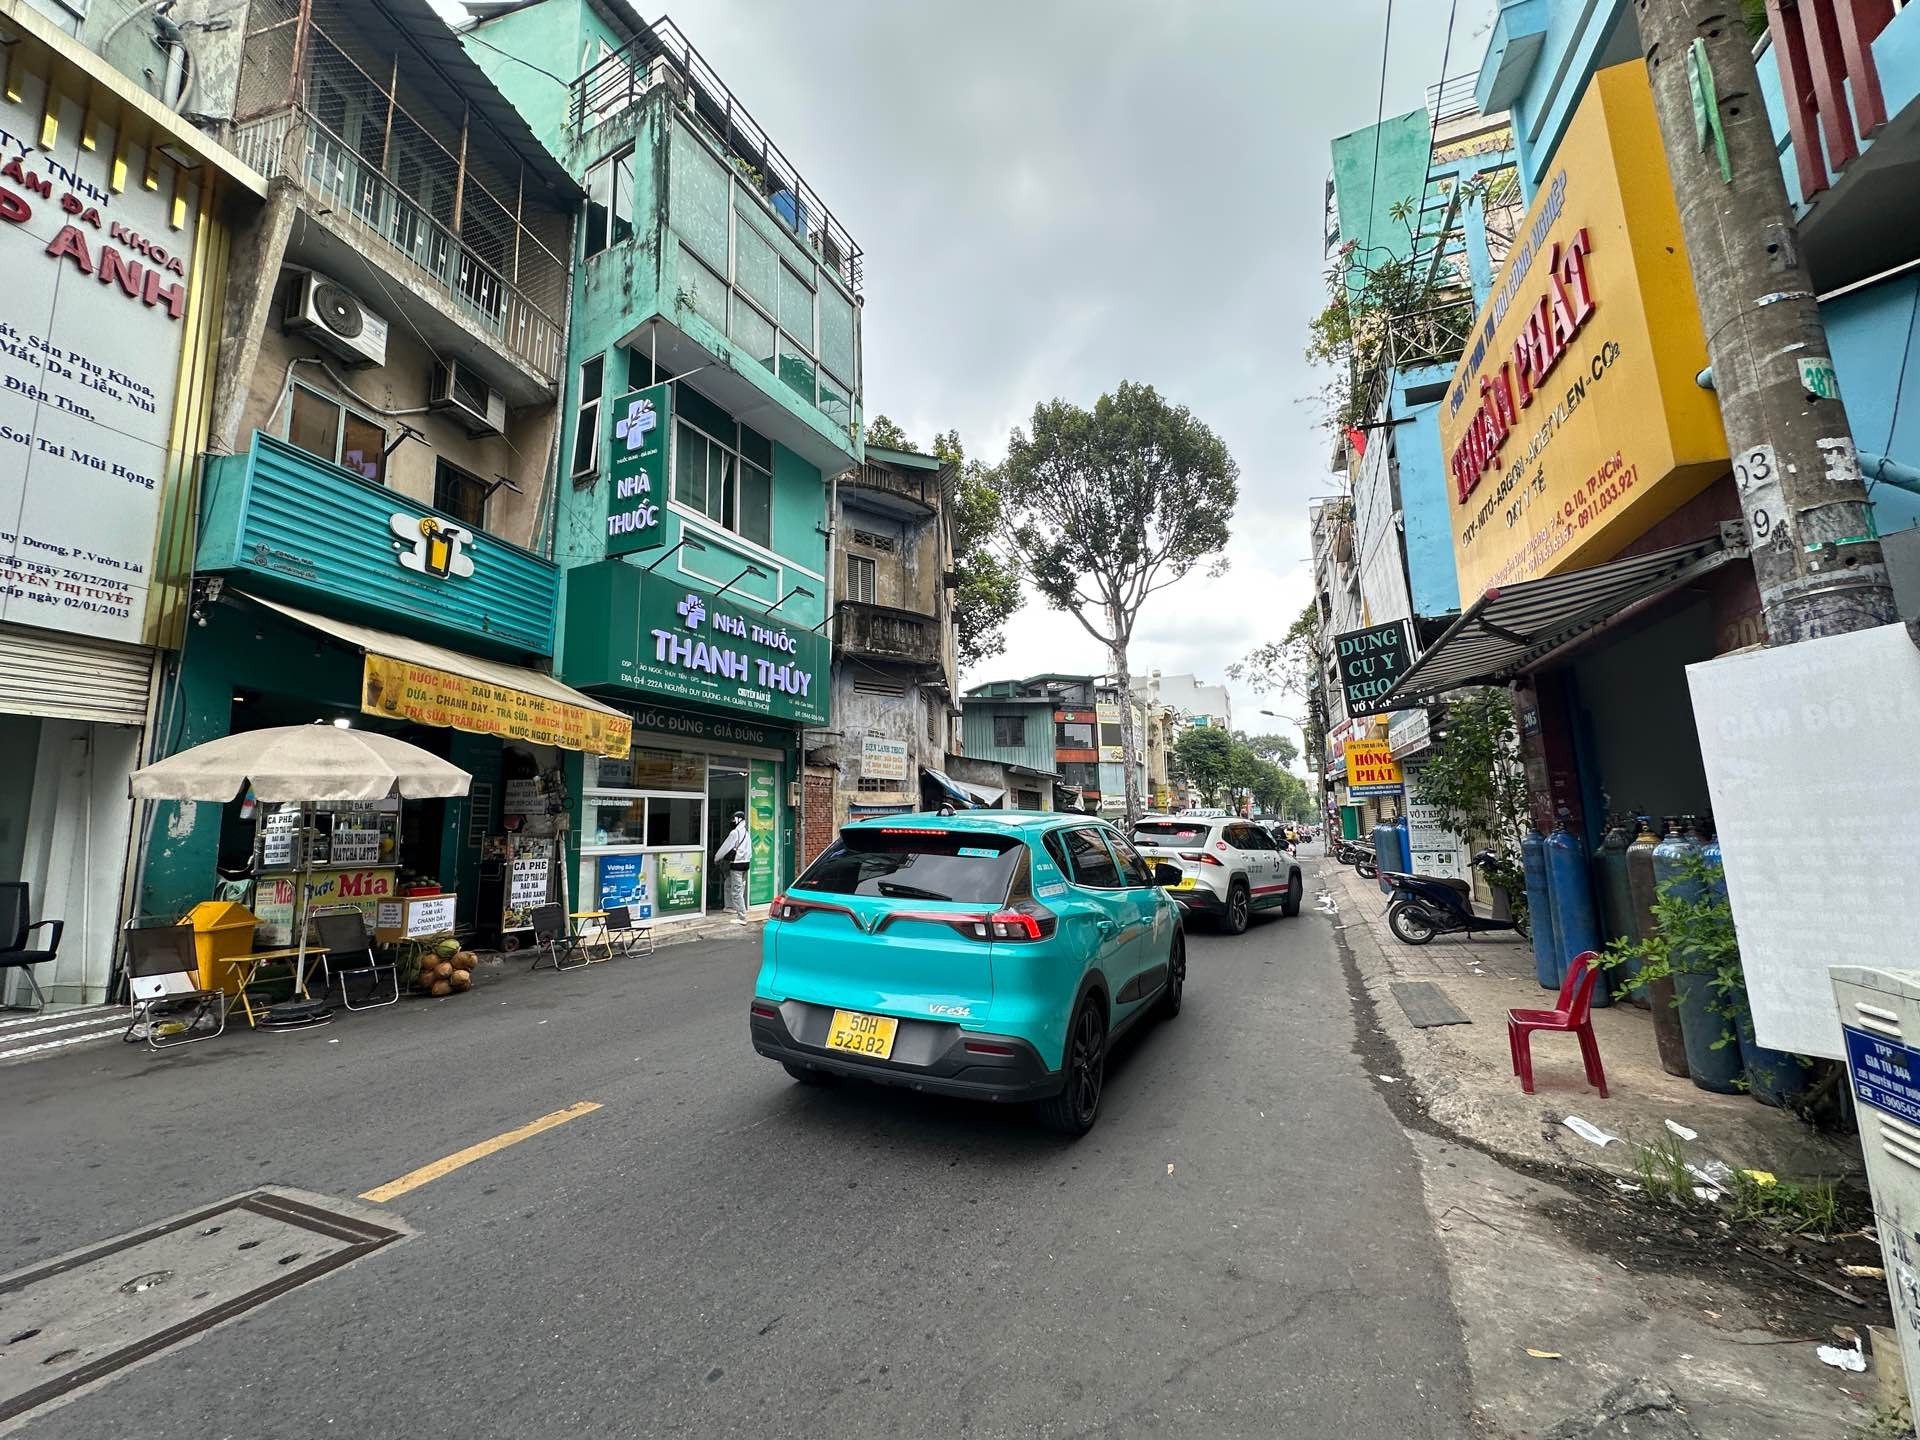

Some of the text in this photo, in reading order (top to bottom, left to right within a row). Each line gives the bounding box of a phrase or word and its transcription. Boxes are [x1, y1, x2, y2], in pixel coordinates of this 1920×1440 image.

[45, 157, 109, 206] TNHH
[60, 192, 101, 229] ĐA
[110, 220, 184, 277] KHOA
[1508, 240, 1533, 302] CÔNG
[1531, 169, 1568, 257] NGHIỆP
[45, 223, 187, 320] ANH
[0, 322, 155, 399] át, Sản Phụ Khoa,
[0, 339, 156, 414] Mắt, Da Liễu, Nhi
[1450, 227, 1596, 505] THUẬN PHÁT
[4, 375, 48, 401] Điện
[0, 426, 155, 489] Soi Tai Mũi Họng
[1586, 450, 1624, 496] TP.HCM
[617, 467, 650, 499] NHÀ
[1505, 460, 1547, 530] OXY Y TẾ
[1578, 463, 1639, 529] 0911.033.921
[608, 499, 659, 536] THUỐC
[1753, 508, 1771, 538] 9
[0, 532, 18, 544] uy
[22, 536, 69, 557] Dương,
[124, 561, 143, 574] Lài
[0, 555, 129, 592] cấp ngày 26/12/2014
[0, 584, 129, 618] cấp ngày 02/01/2013
[54, 580, 82, 597] THỊ
[85, 587, 133, 605] TUYẾT
[712, 612, 747, 638] NHÀ
[752, 624, 797, 654] THUỐC
[1337, 628, 1398, 657] DỤNG
[651, 629, 812, 697] THANH THÚY
[1348, 652, 1395, 677] CỤ Y
[471, 686, 490, 698] RAU
[621, 673, 633, 683] ĐỊA
[664, 682, 687, 695] NGUYỄN
[689, 688, 700, 697] DUY
[1346, 675, 1398, 700] KHO
[436, 694, 468, 710] CHANH
[534, 716, 562, 729] MATCH
[1368, 700, 1375, 710] Y
[628, 707, 764, 743] HUỐC ĐÚNG GIÁ ĐÚNG
[1356, 766, 1394, 782] PHÁT
[338, 872, 389, 897] Mía
[607, 864, 625, 872] Vương
[850, 1015, 879, 1035] 50H
[928, 1003, 948, 1015] VF
[834, 1030, 885, 1055] 523.82
[1873, 1042, 1893, 1057] TPP
